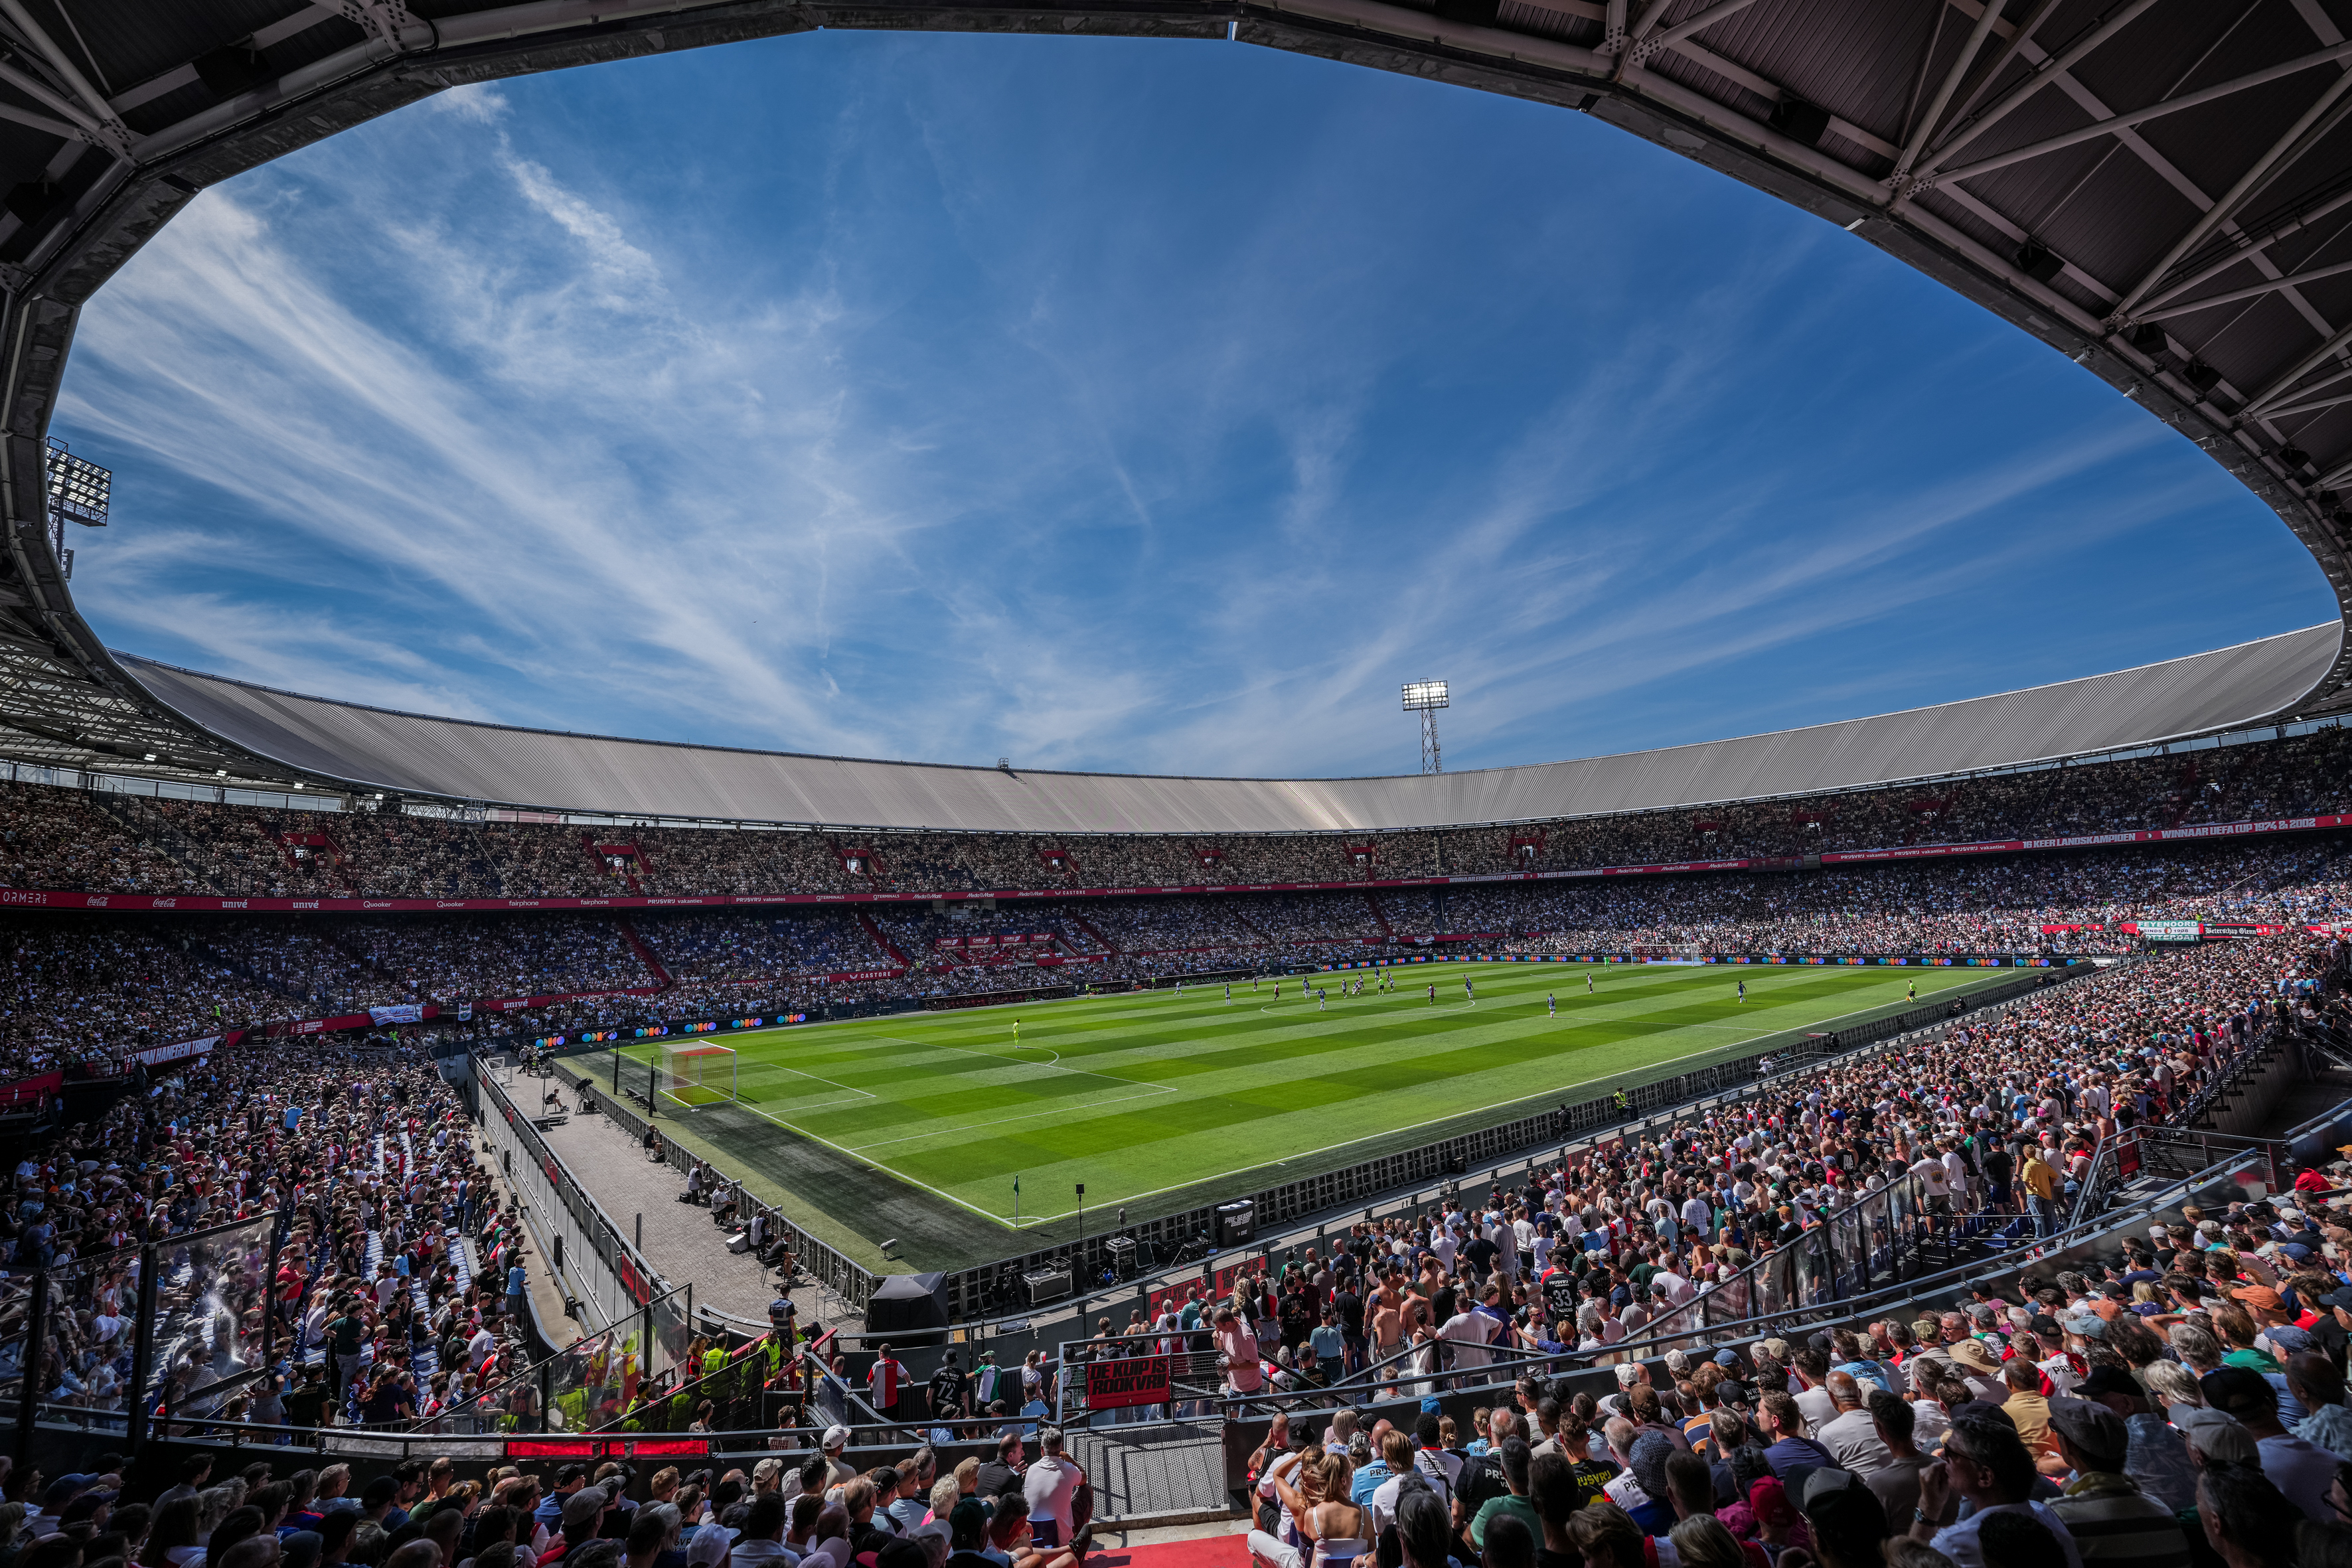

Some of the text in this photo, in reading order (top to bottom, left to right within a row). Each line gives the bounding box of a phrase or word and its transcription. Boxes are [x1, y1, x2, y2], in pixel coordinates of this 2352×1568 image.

[2161, 827, 2209, 838] WINNAAR
[2210, 824, 2234, 835] UEFA
[2234, 823, 2253, 833] CUP
[2254, 821, 2277, 832] 1974
[2289, 817, 2316, 828] 2002
[2033, 839, 2056, 848] KEER
[2056, 832, 2136, 846] LANDSKAMPIOEN
[222, 899, 248, 909] univé
[293, 900, 319, 909] univé
[2204, 927, 2238, 935] Beterschap
[503, 998, 528, 1008] univé
[155, 1041, 192, 1064] HANEGEM
[1224, 1210, 1253, 1224] PRE-SEASON
[1222, 1269, 1233, 1280] DE
[1252, 1259, 1260, 1269] IS
[1160, 1289, 1172, 1300] HET
[1553, 1289, 1573, 1307] 33
[1152, 1300, 1160, 1310] DE
[1090, 1358, 1168, 1380] DE KUIP IS
[937, 1381, 956, 1401] 72
